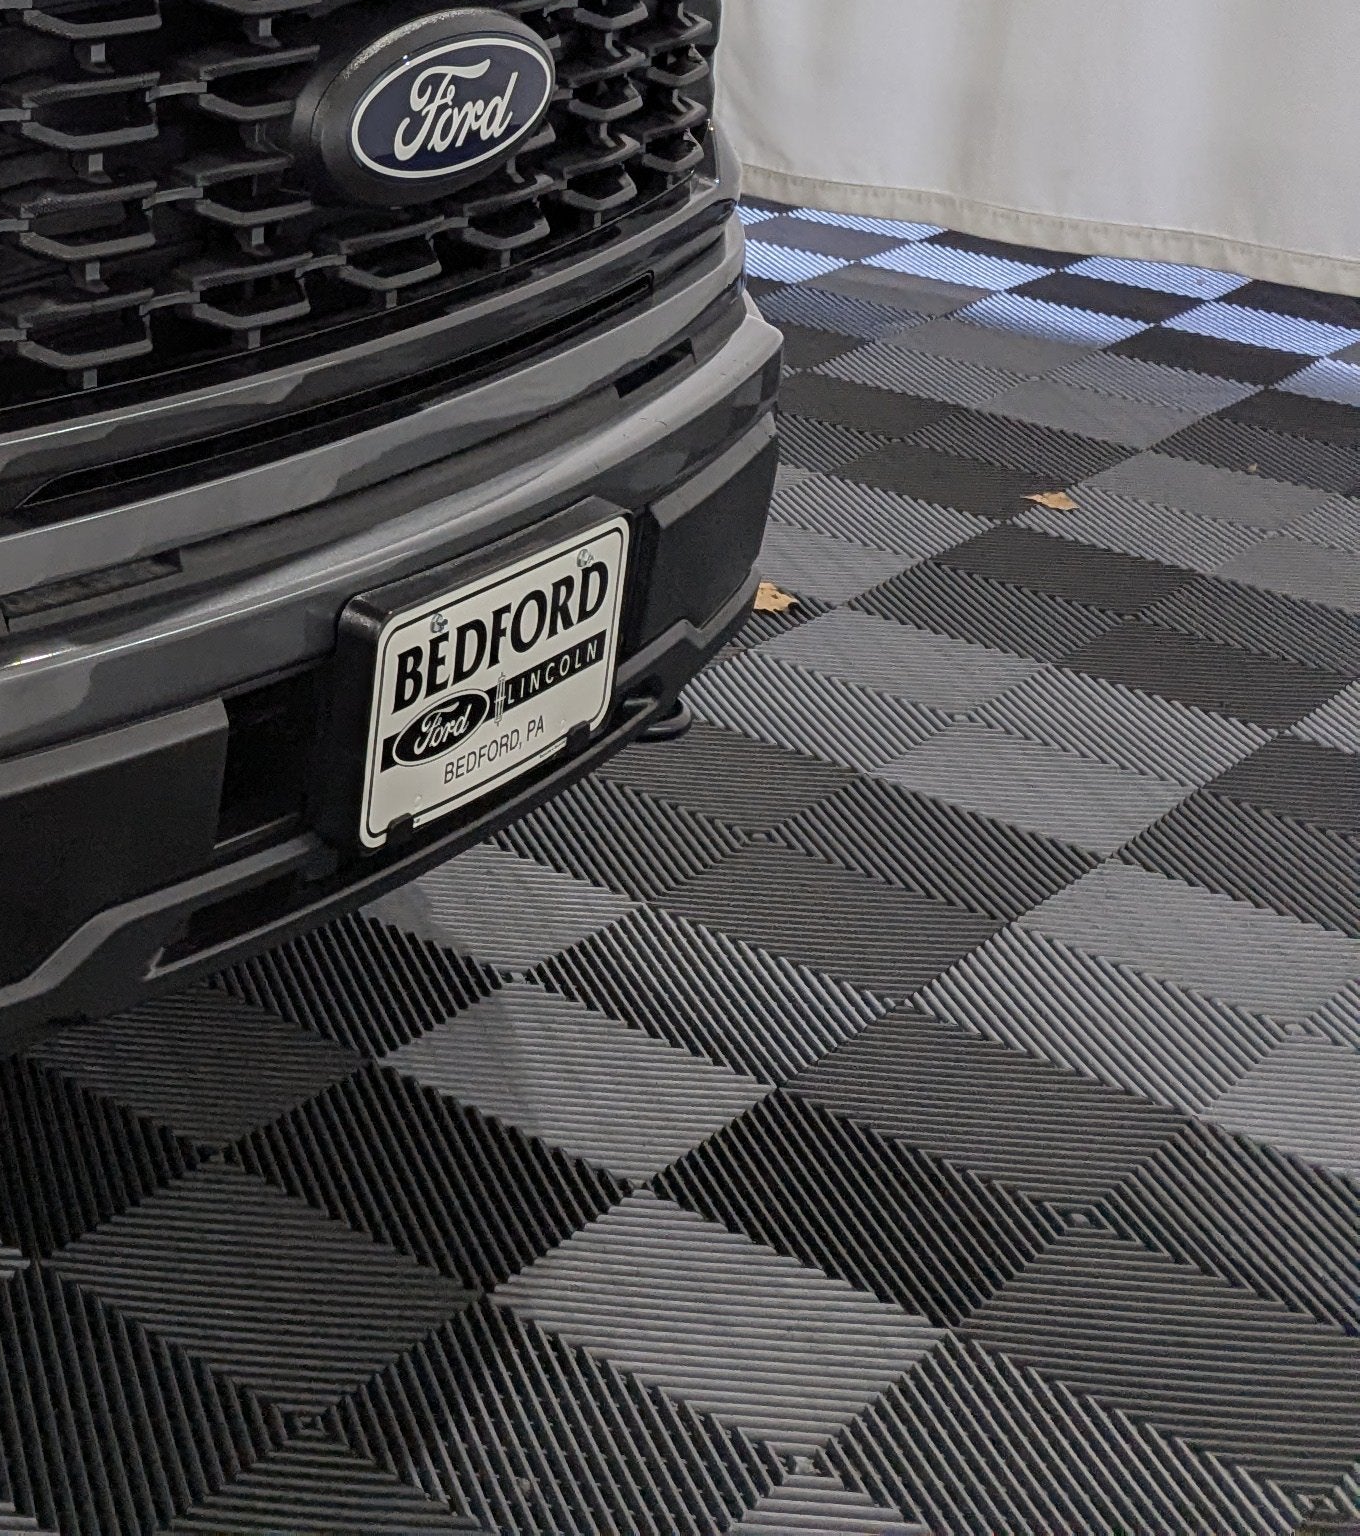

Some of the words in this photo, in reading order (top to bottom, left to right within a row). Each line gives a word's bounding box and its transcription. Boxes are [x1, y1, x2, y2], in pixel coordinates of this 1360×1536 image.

[394, 58, 519, 162] Ford
[391, 561, 610, 715] BEDFORD
[413, 703, 473, 755] Ford
[504, 639, 600, 706] LINCOLN
[443, 728, 524, 785] BEDFORD,
[525, 719, 545, 746] PA
